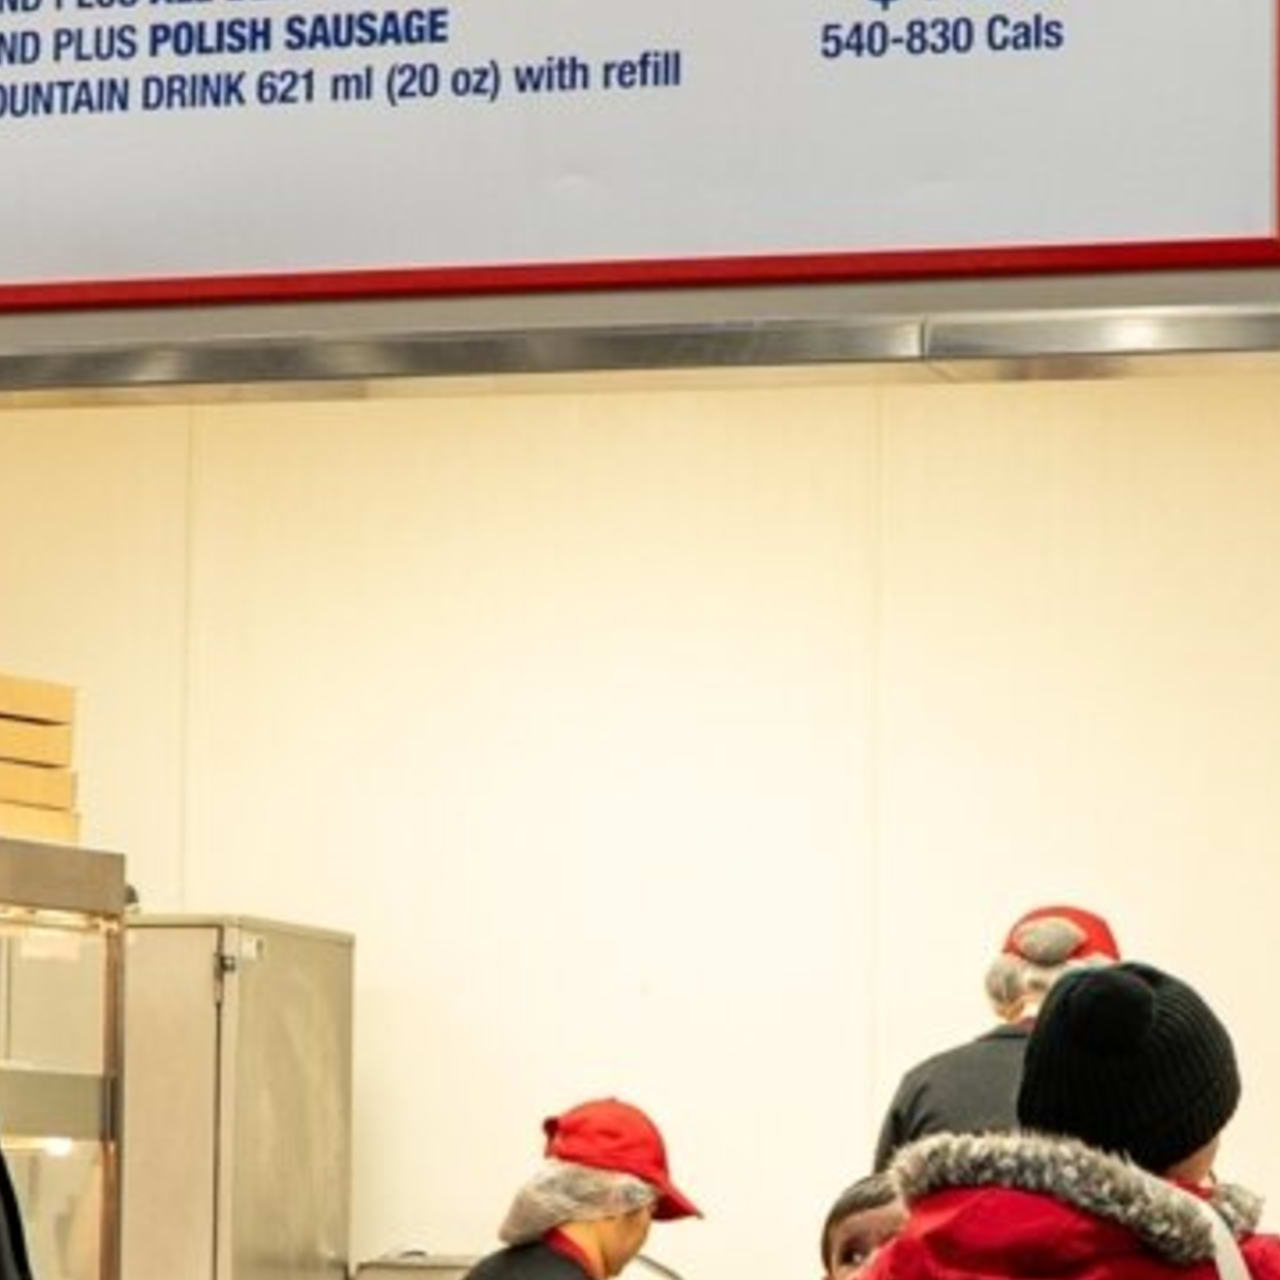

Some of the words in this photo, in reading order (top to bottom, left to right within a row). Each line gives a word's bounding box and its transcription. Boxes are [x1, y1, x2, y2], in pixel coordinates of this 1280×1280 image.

[53, 24, 137, 62] PLUS
[149, 18, 271, 57] POLISH
[284, 9, 449, 51] SAUSAGE
[821, 16, 975, 59] 540-830
[986, 13, 1064, 51] Cals
[141, 72, 246, 111] DRINK
[256, 68, 315, 105] 621
[331, 66, 373, 101] ml
[386, 62, 439, 107] (20
[450, 59, 501, 103] oz)
[515, 56, 588, 93] with
[602, 50, 681, 90] refill
